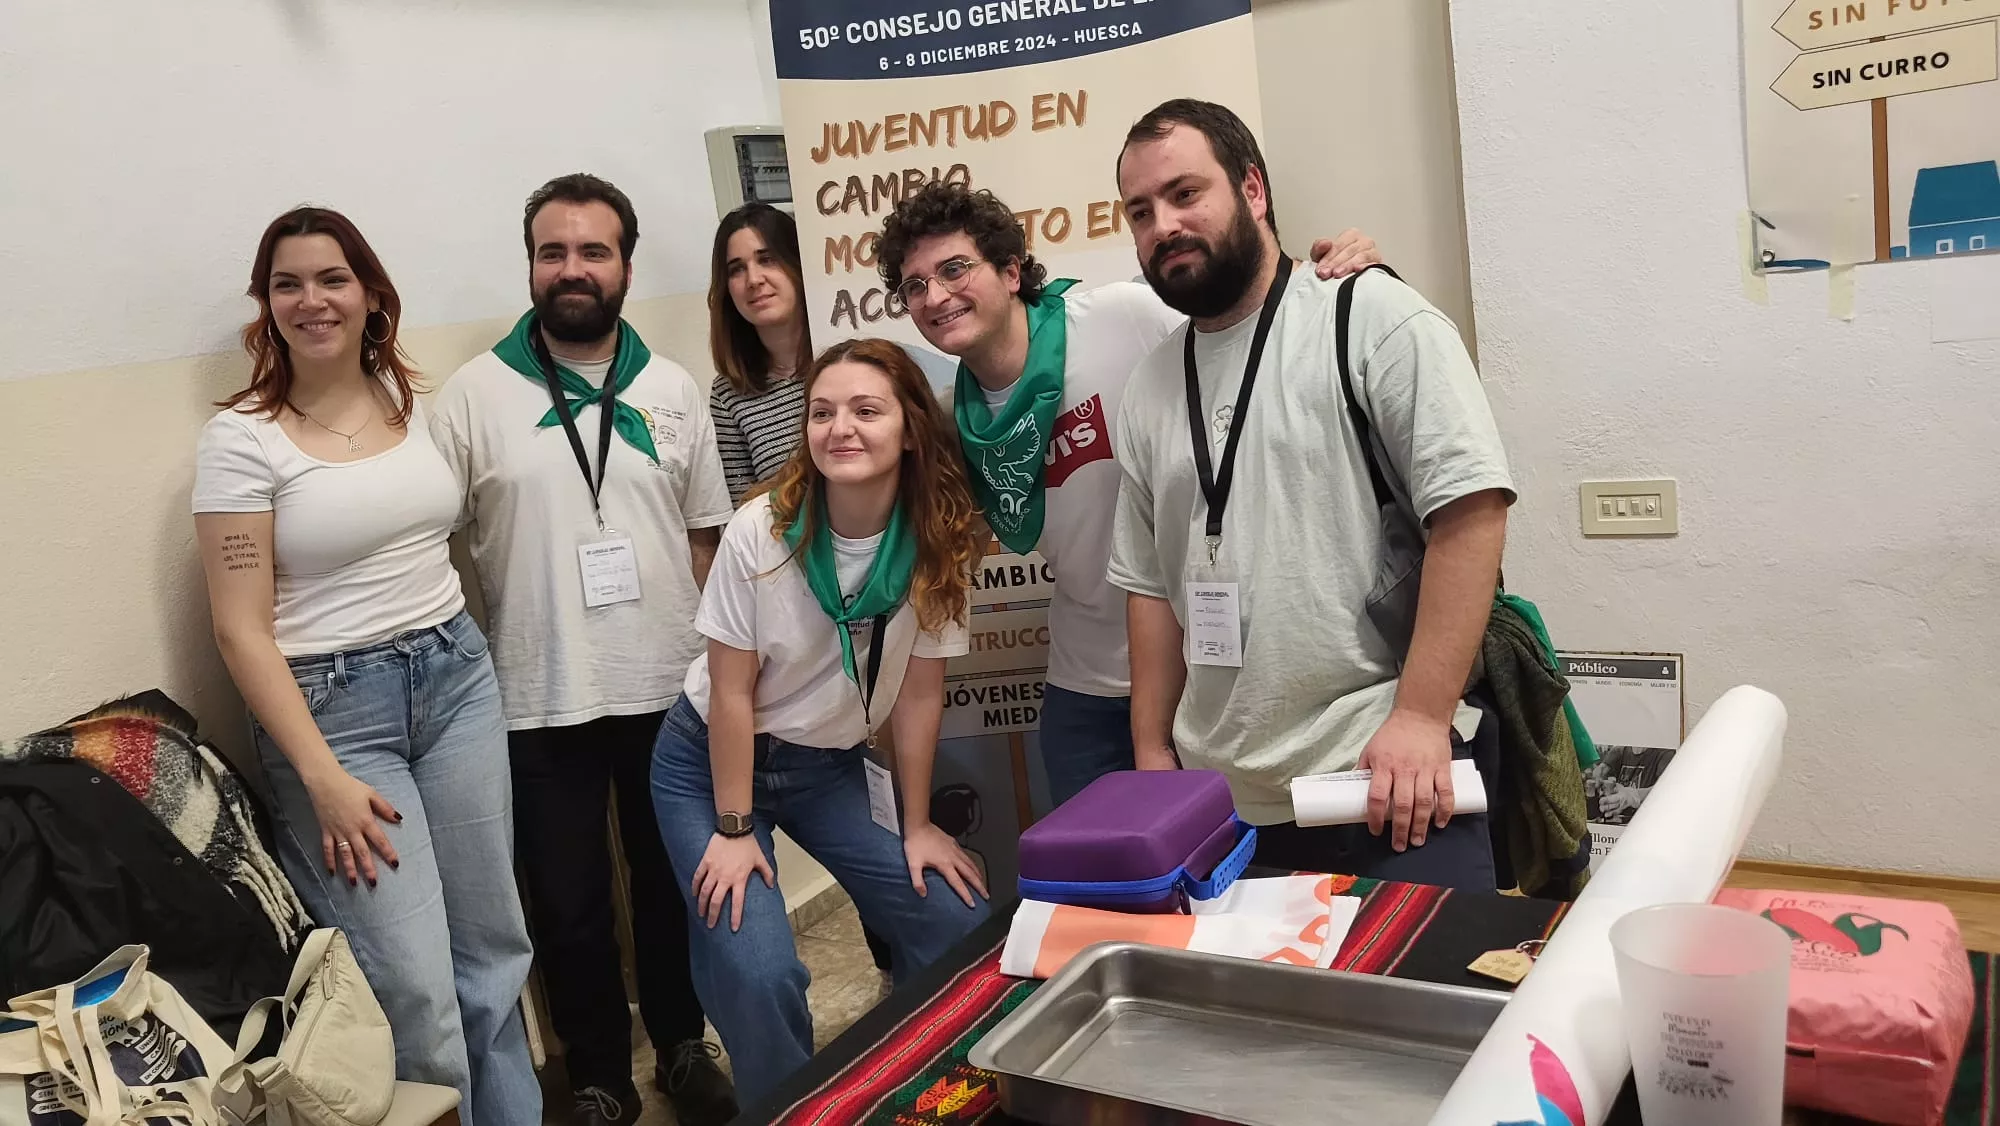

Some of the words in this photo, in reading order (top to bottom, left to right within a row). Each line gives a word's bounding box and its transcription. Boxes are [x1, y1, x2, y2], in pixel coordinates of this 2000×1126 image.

[800, 25, 840, 50] 50º
[846, 9, 962, 44] CONSEJO
[968, 0, 1087, 27] GENERAL
[1808, 2, 1865, 30] SIN
[879, 57, 889, 71] 6
[906, 53, 915, 67] 8
[920, 39, 1010, 65] DICIEMBRE
[1015, 33, 1057, 52] 2024
[1074, 22, 1143, 44] HUESCA
[1812, 67, 1851, 89] SIN
[1860, 52, 1949, 81] CURRO
[810, 99, 1018, 164] JUVENTUD
[1031, 89, 1088, 131] EN
[1568, 661, 1617, 674] Público
[943, 682, 1044, 708] JÓVENES
[983, 706, 1041, 728] MIED
